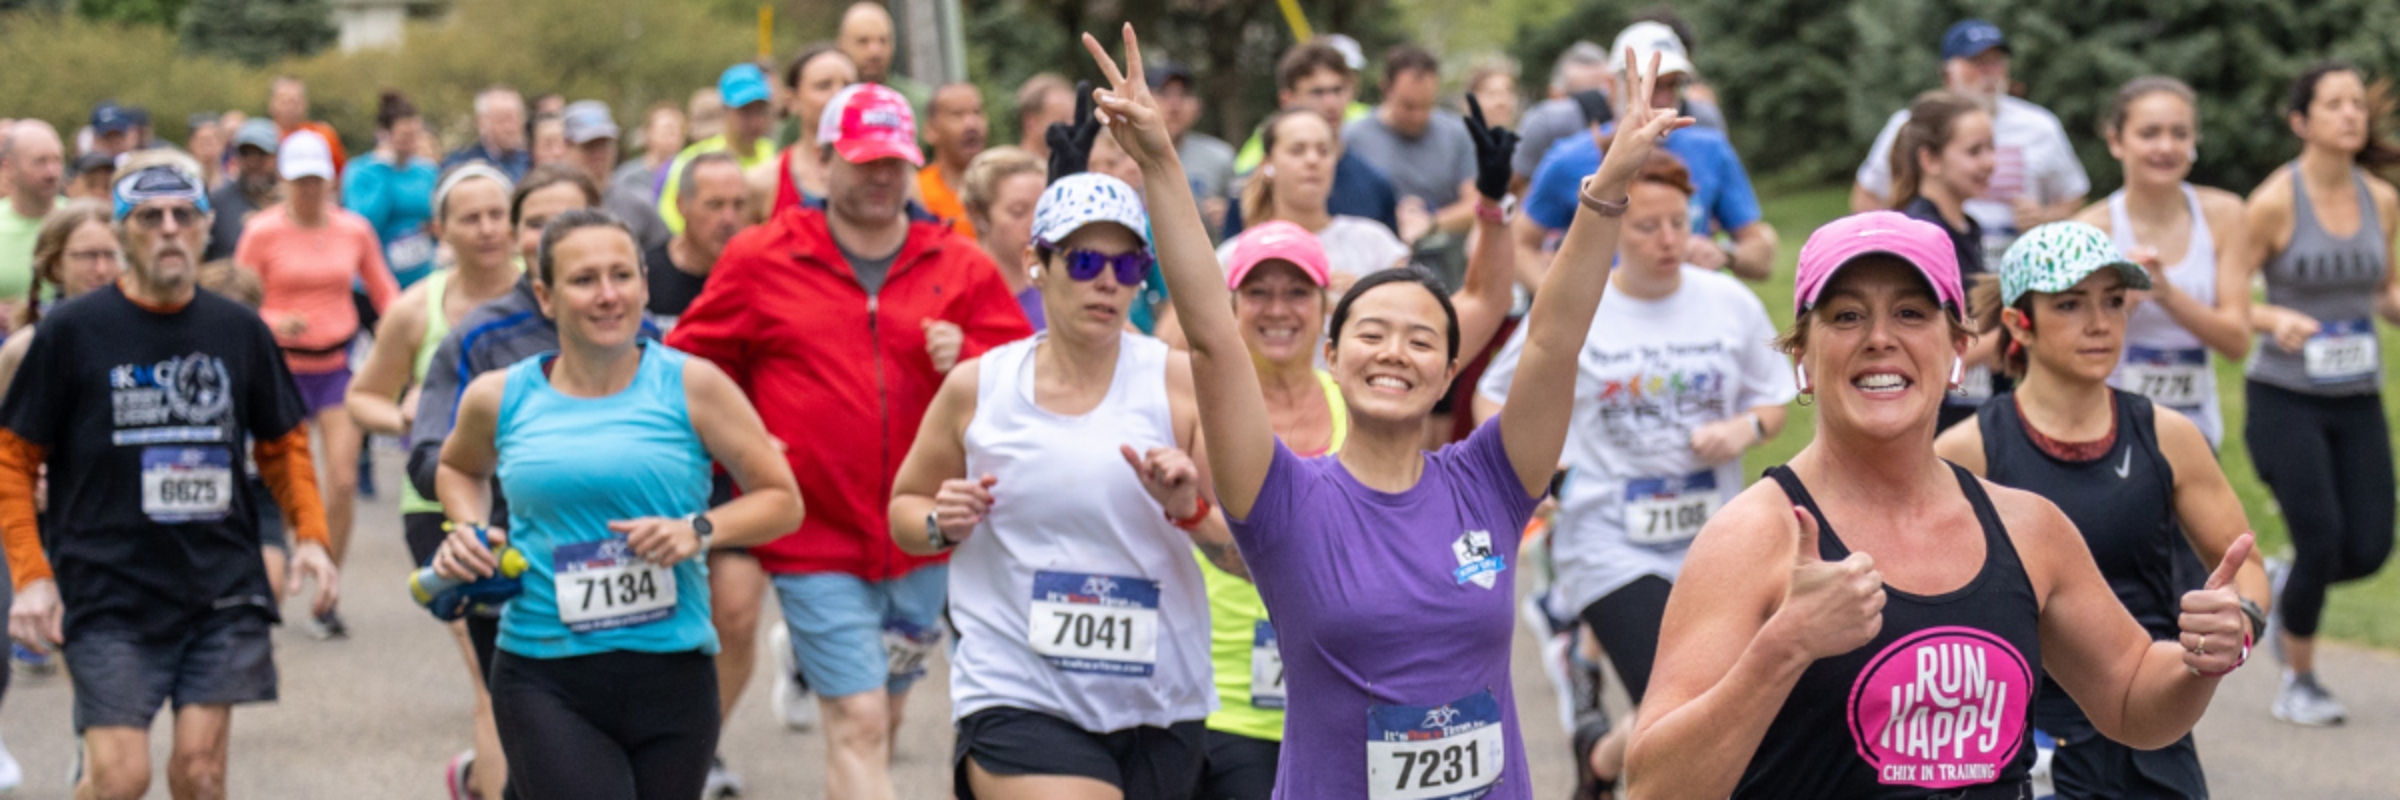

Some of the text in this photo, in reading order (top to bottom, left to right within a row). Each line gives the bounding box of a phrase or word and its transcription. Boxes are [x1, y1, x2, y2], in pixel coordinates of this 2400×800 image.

[576, 568, 657, 612] 7134
[1052, 610, 1133, 651] 7041
[1915, 643, 1987, 709] RUN
[1880, 679, 2007, 760] HAPPY
[1391, 739, 1480, 791] 7231
[1882, 762, 1996, 782] CHIX IN TRAINING
